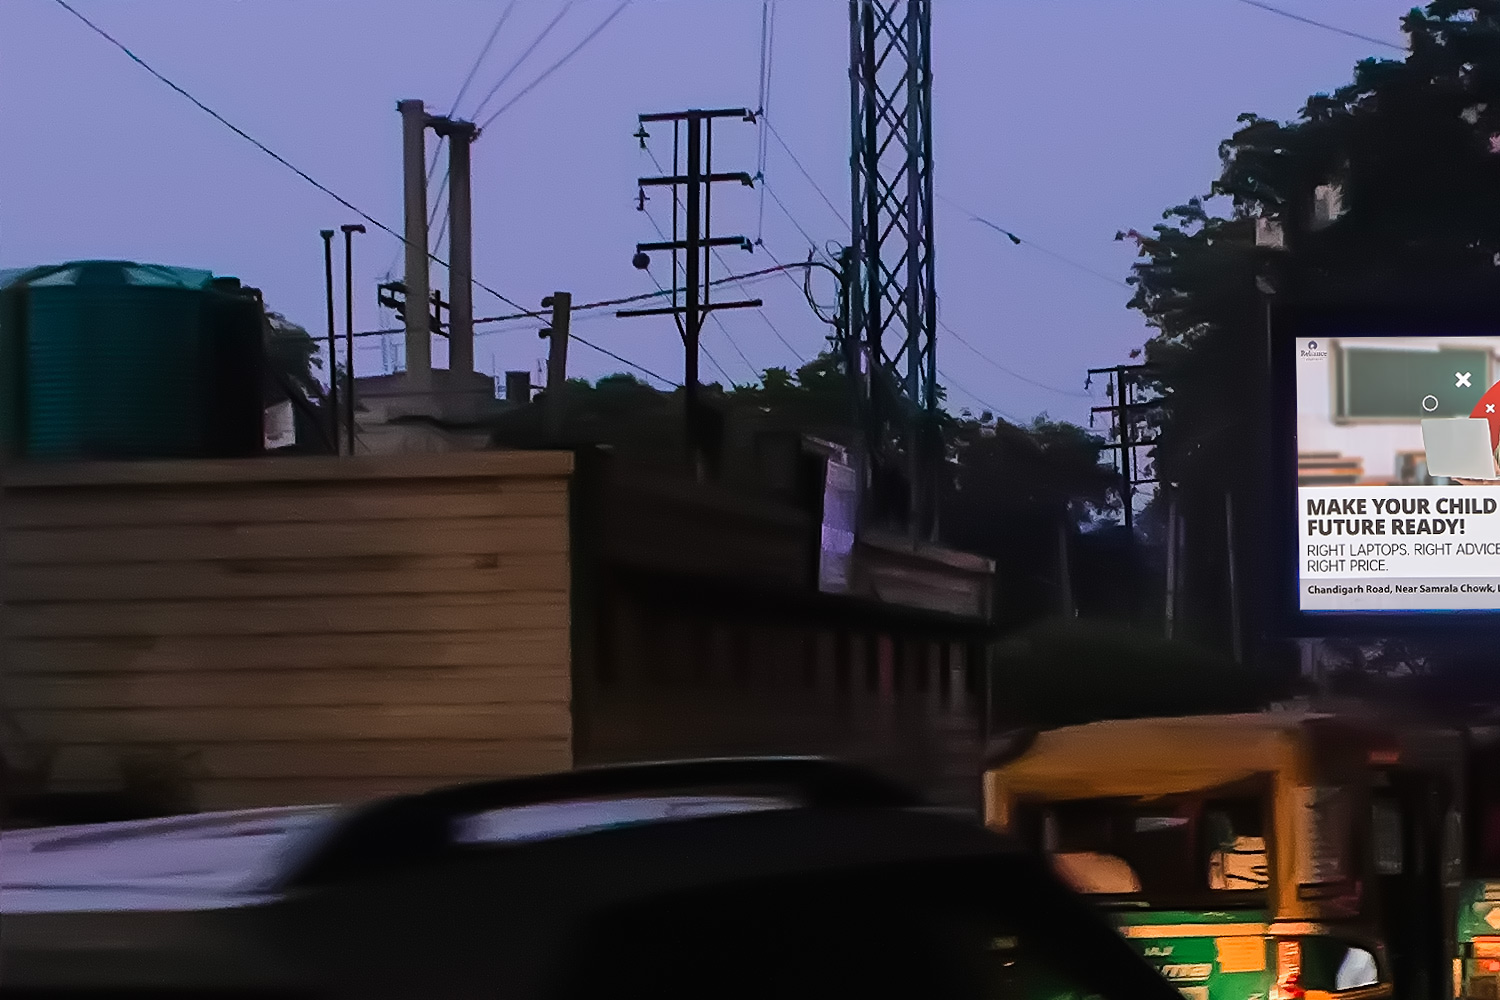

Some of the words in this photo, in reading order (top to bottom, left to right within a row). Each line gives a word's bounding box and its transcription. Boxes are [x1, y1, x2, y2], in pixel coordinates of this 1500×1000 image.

[1307, 498, 1367, 515] MAKE
[1372, 498, 1430, 514] YOUR
[1435, 498, 1498, 514] CHILD
[1307, 519, 1386, 536] FUTURE
[1391, 518, 1466, 535] READY!
[1307, 544, 1345, 556] RIGHT
[1350, 544, 1410, 556] LAPTOPS.
[1414, 543, 1452, 556] RIGHT
[1307, 560, 1345, 572] RIGHT
[1350, 559, 1389, 572] PRICE.
[1308, 584, 1364, 596] Chandigarh
[1366, 584, 1393, 594] Road,
[1395, 584, 1418, 594] Near
[1420, 584, 1459, 594] Samrala
[1460, 583, 1496, 594] Chowk,
